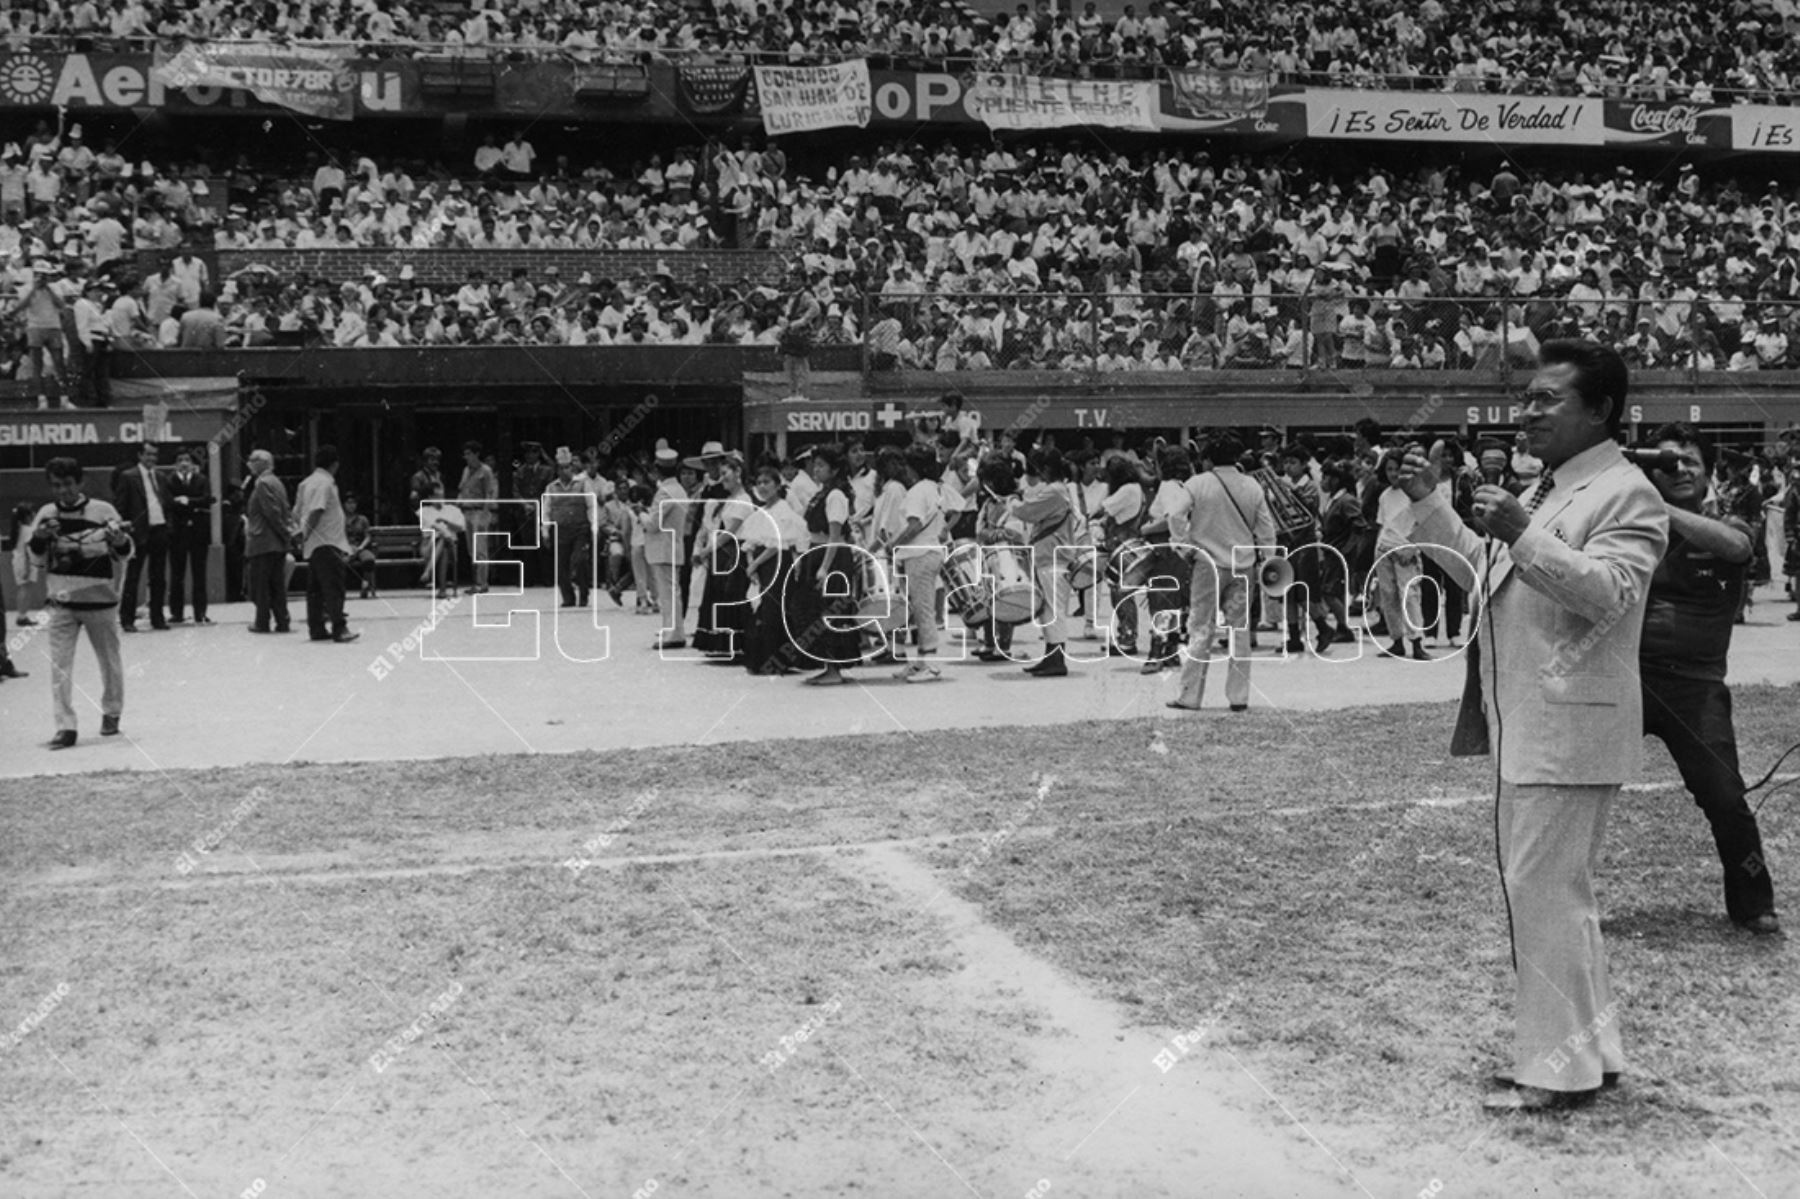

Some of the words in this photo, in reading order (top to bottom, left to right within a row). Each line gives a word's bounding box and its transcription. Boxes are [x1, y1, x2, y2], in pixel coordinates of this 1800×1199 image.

[1384, 108, 1452, 133] Sentir
[1457, 107, 1490, 131] De
[0, 422, 100, 445] GUARDIA
[119, 421, 183, 442] CIIL
[787, 411, 870, 431] SERVICIO
